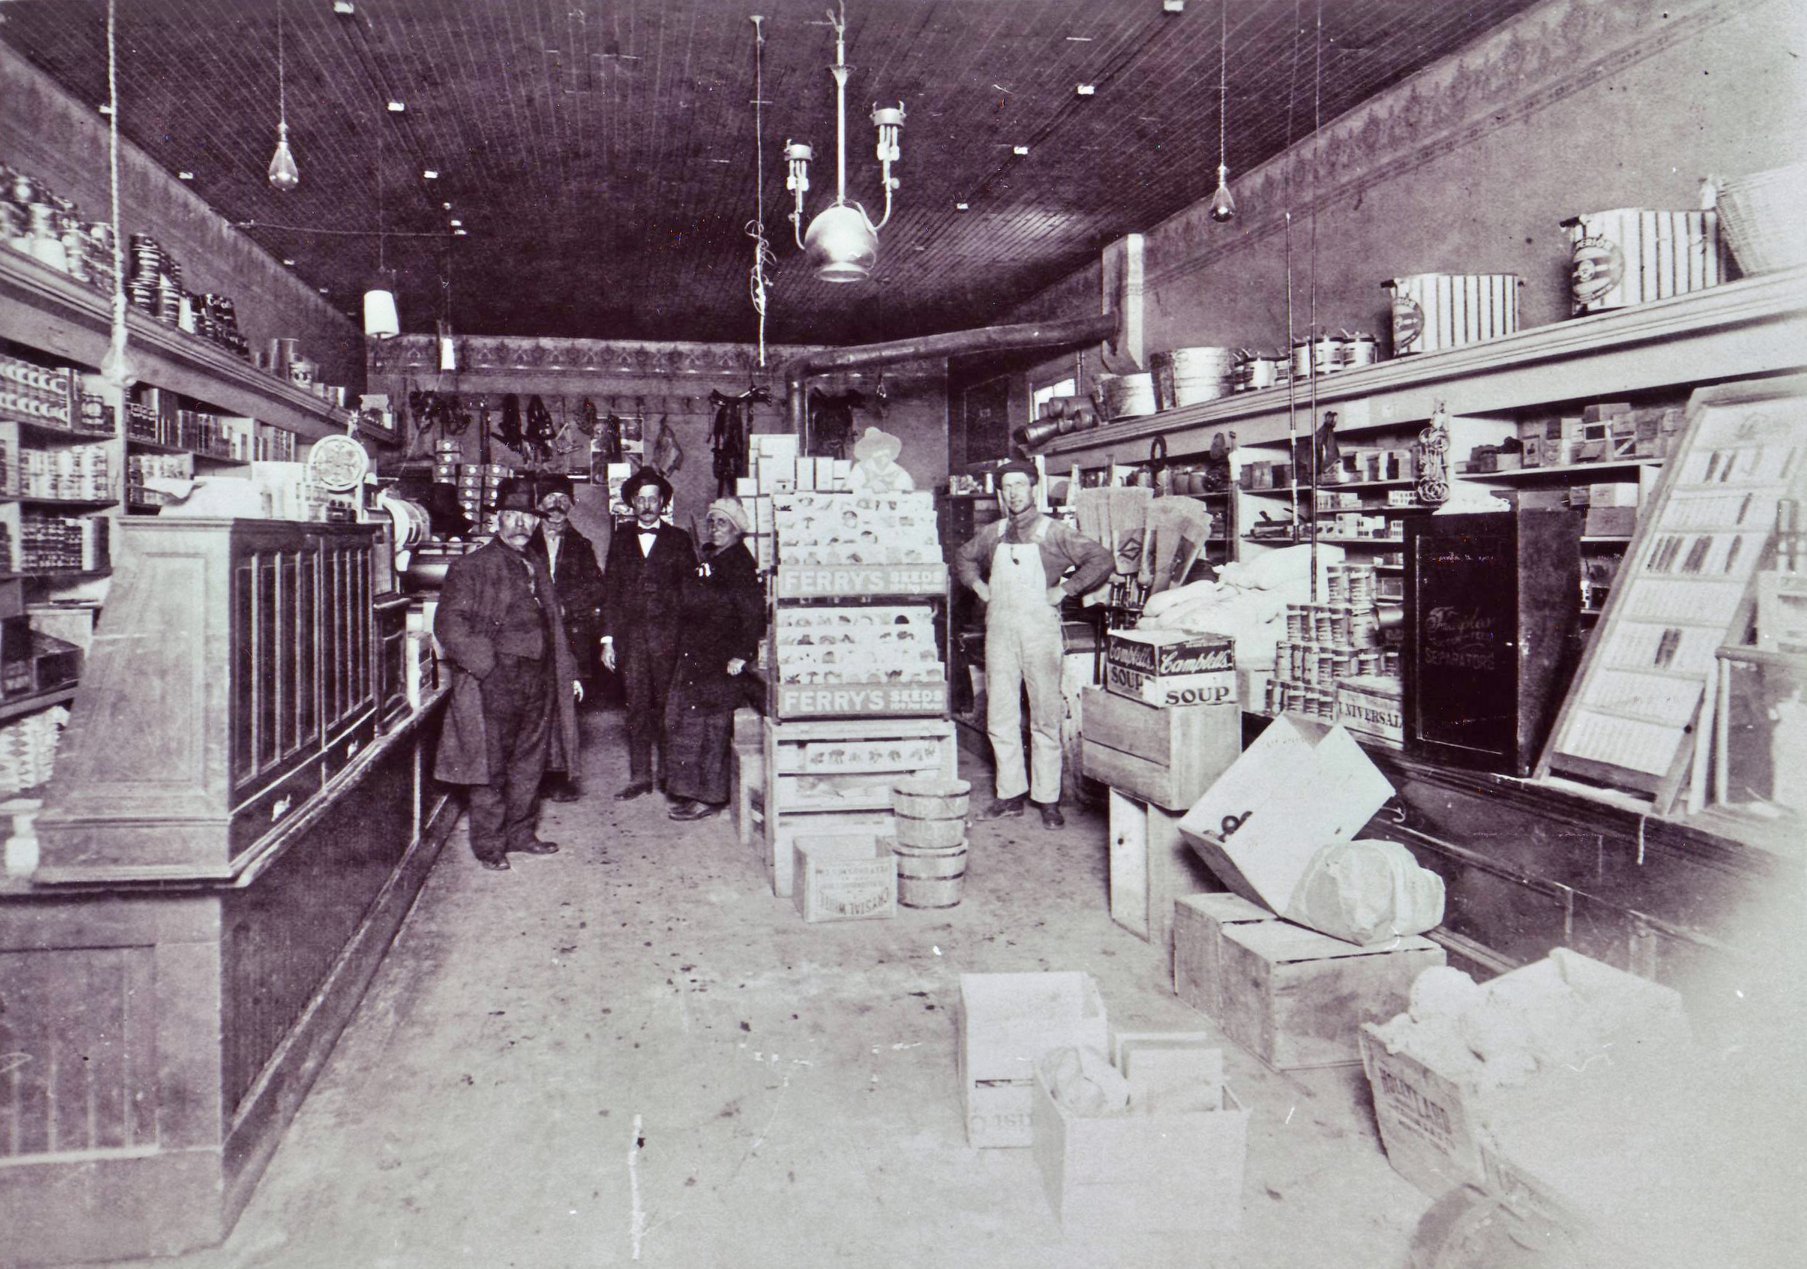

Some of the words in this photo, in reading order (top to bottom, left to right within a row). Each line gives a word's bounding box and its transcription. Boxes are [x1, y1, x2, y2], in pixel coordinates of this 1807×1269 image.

[889, 571, 944, 583] SEEDS
[1111, 666, 1144, 691] SOUP
[784, 690, 885, 712] FERRY'S
[889, 690, 944, 701] SEEDS
[1165, 686, 1230, 704] SOUP
